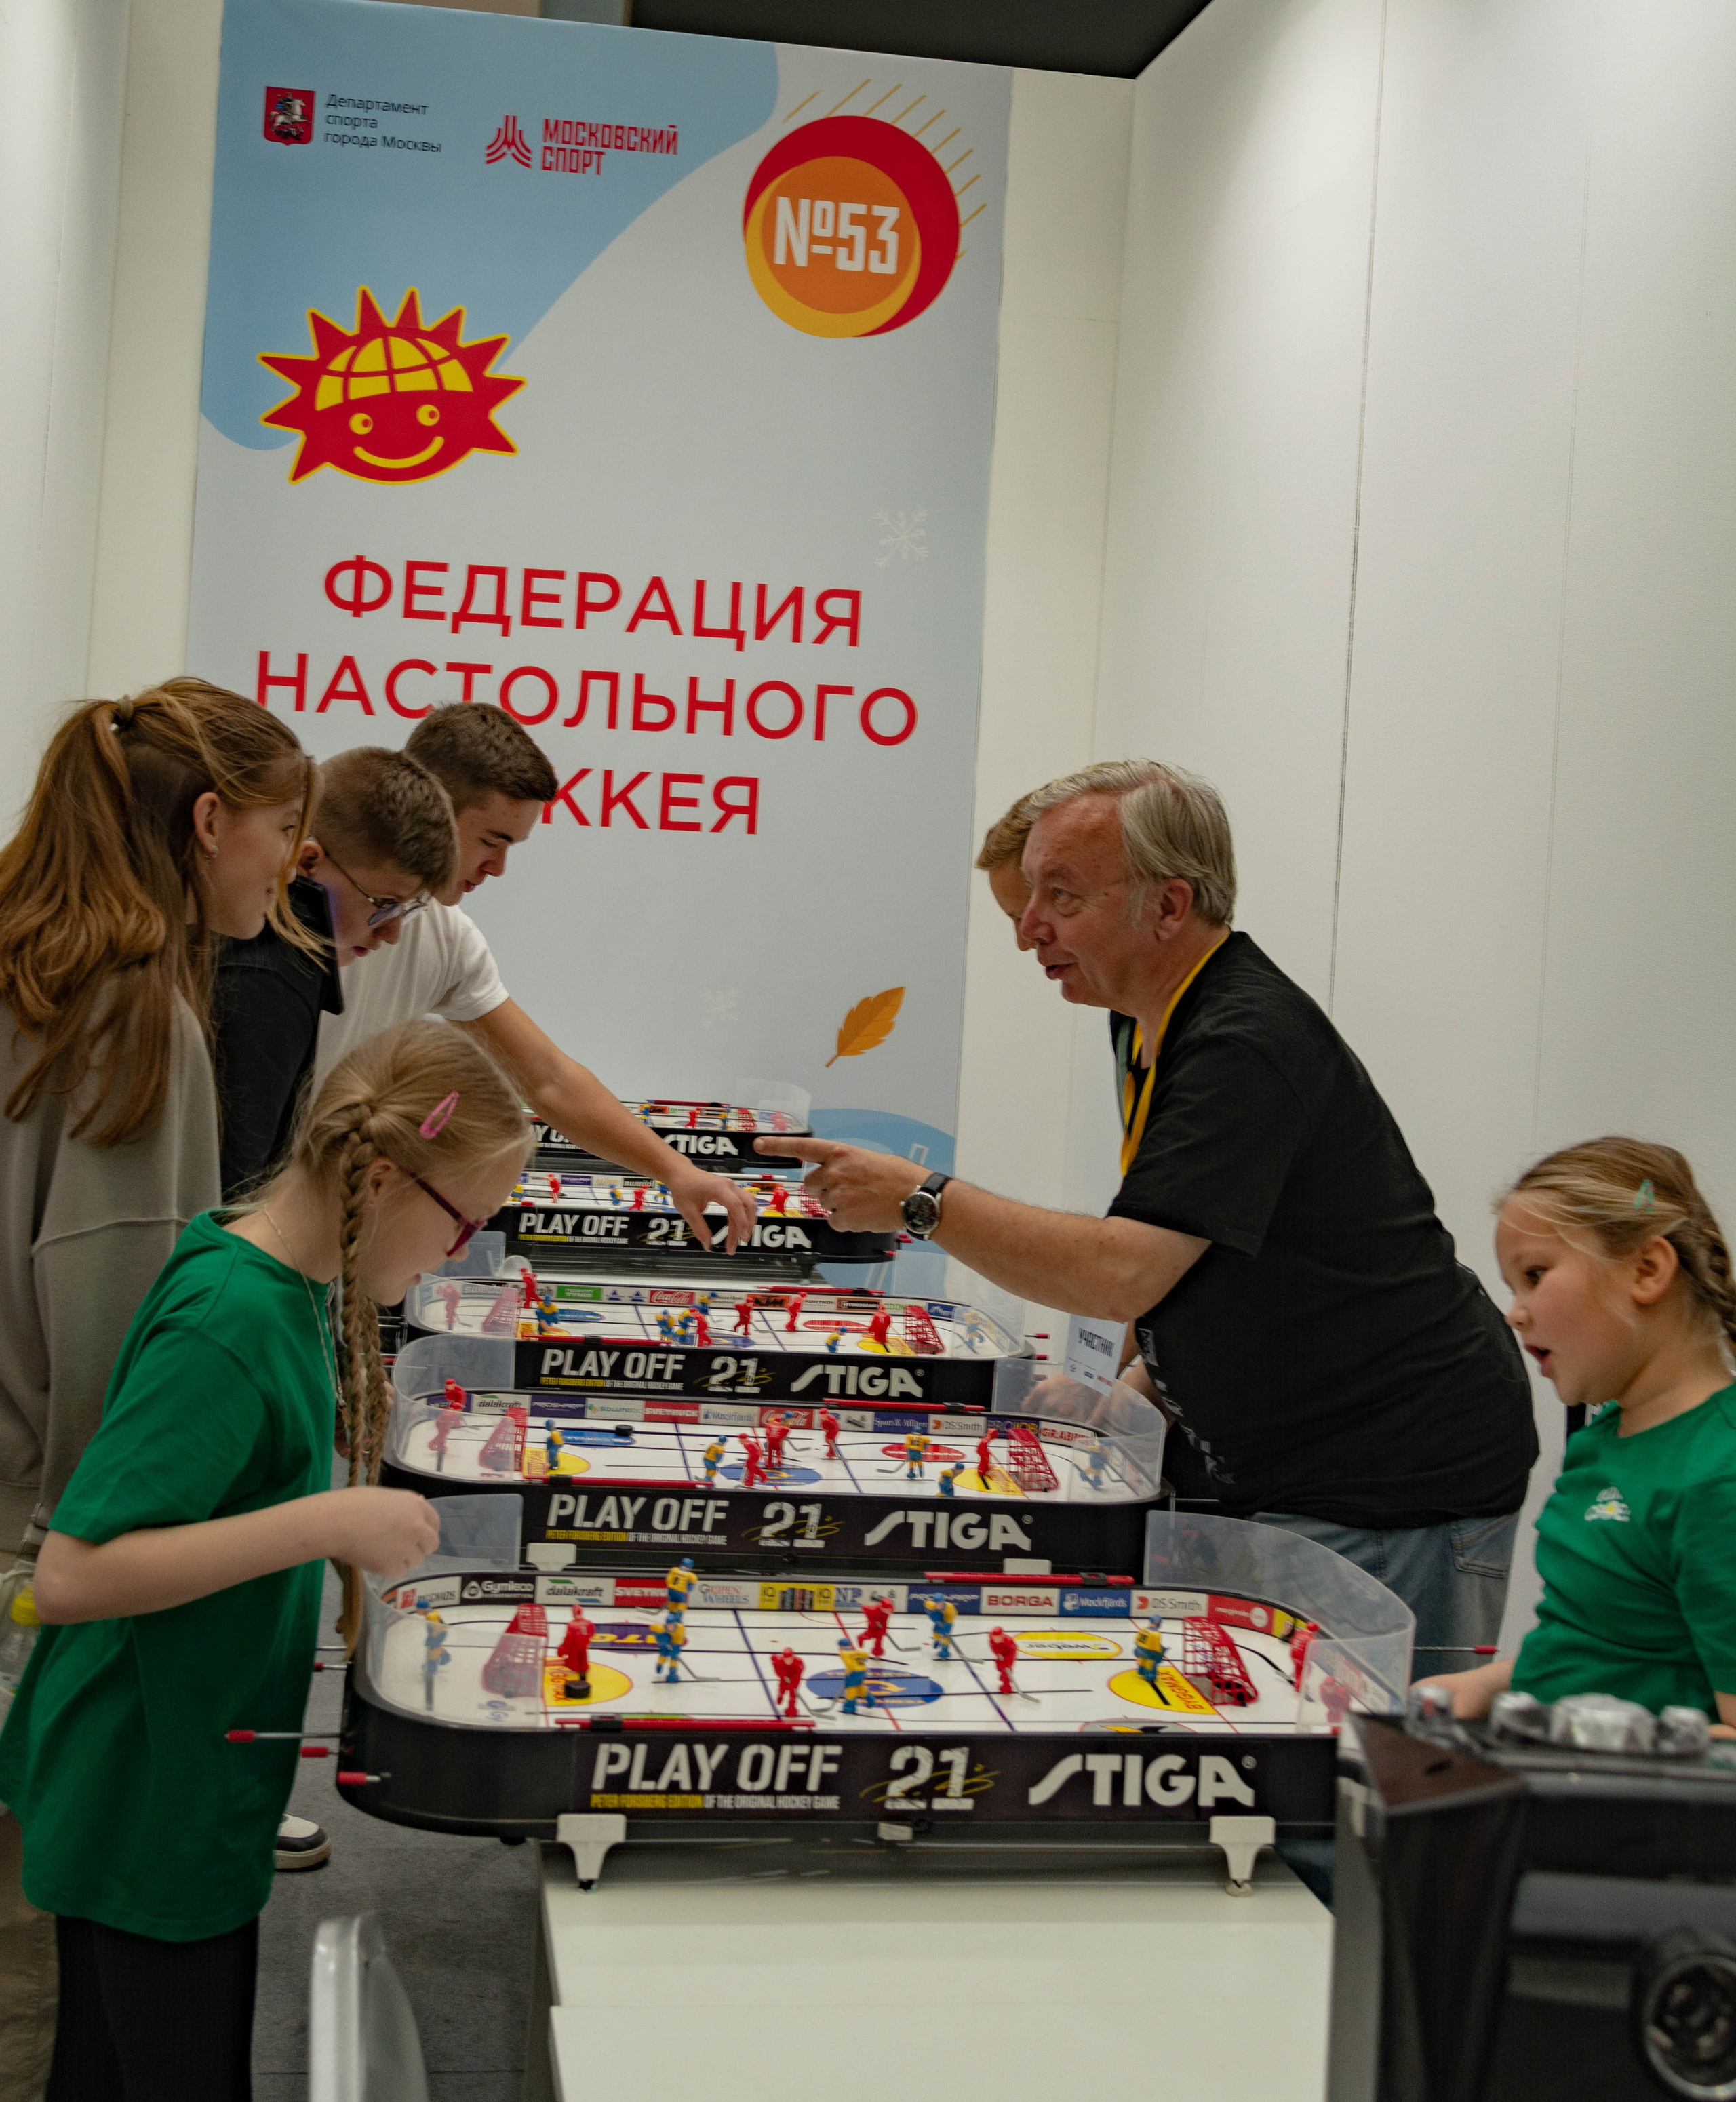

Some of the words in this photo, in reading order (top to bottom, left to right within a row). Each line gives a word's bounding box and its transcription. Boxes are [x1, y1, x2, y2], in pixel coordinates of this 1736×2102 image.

[325, 94, 429, 115] Департамент
[325, 112, 378, 131] спорта
[323, 131, 377, 150] города
[381, 133, 442, 153] Москвы
[542, 118, 678, 155] МОСКОВСКИЙ
[541, 146, 606, 176] СПОРТ
[323, 554, 863, 652] ФЕДЕРАЦИЯ
[256, 650, 918, 747] НАСТОЛЬНОГО
[541, 767, 761, 836] ККЕЯ
[519, 1213, 580, 1235] PLAY
[582, 1214, 630, 1237] OFF
[646, 1218, 688, 1247] 21
[541, 1349, 620, 1378] PLAY
[623, 1352, 686, 1381] OFF
[707, 1356, 761, 1393] 21
[790, 1364, 924, 1398] STIGA
[547, 1494, 646, 1529] PLAY
[651, 1498, 730, 1532] OFF
[758, 1501, 826, 1549] 21
[864, 1511, 1032, 1551] STIGA
[481, 1580, 535, 1593] Gymleco
[987, 1594, 1054, 1608] BORGA
[1168, 1598, 1202, 1612] Smith
[591, 1743, 730, 1791] PLAY
[736, 1744, 843, 1792] OFF
[884, 1745, 974, 1810] 21
[1028, 1753, 1255, 1808] STIGA
